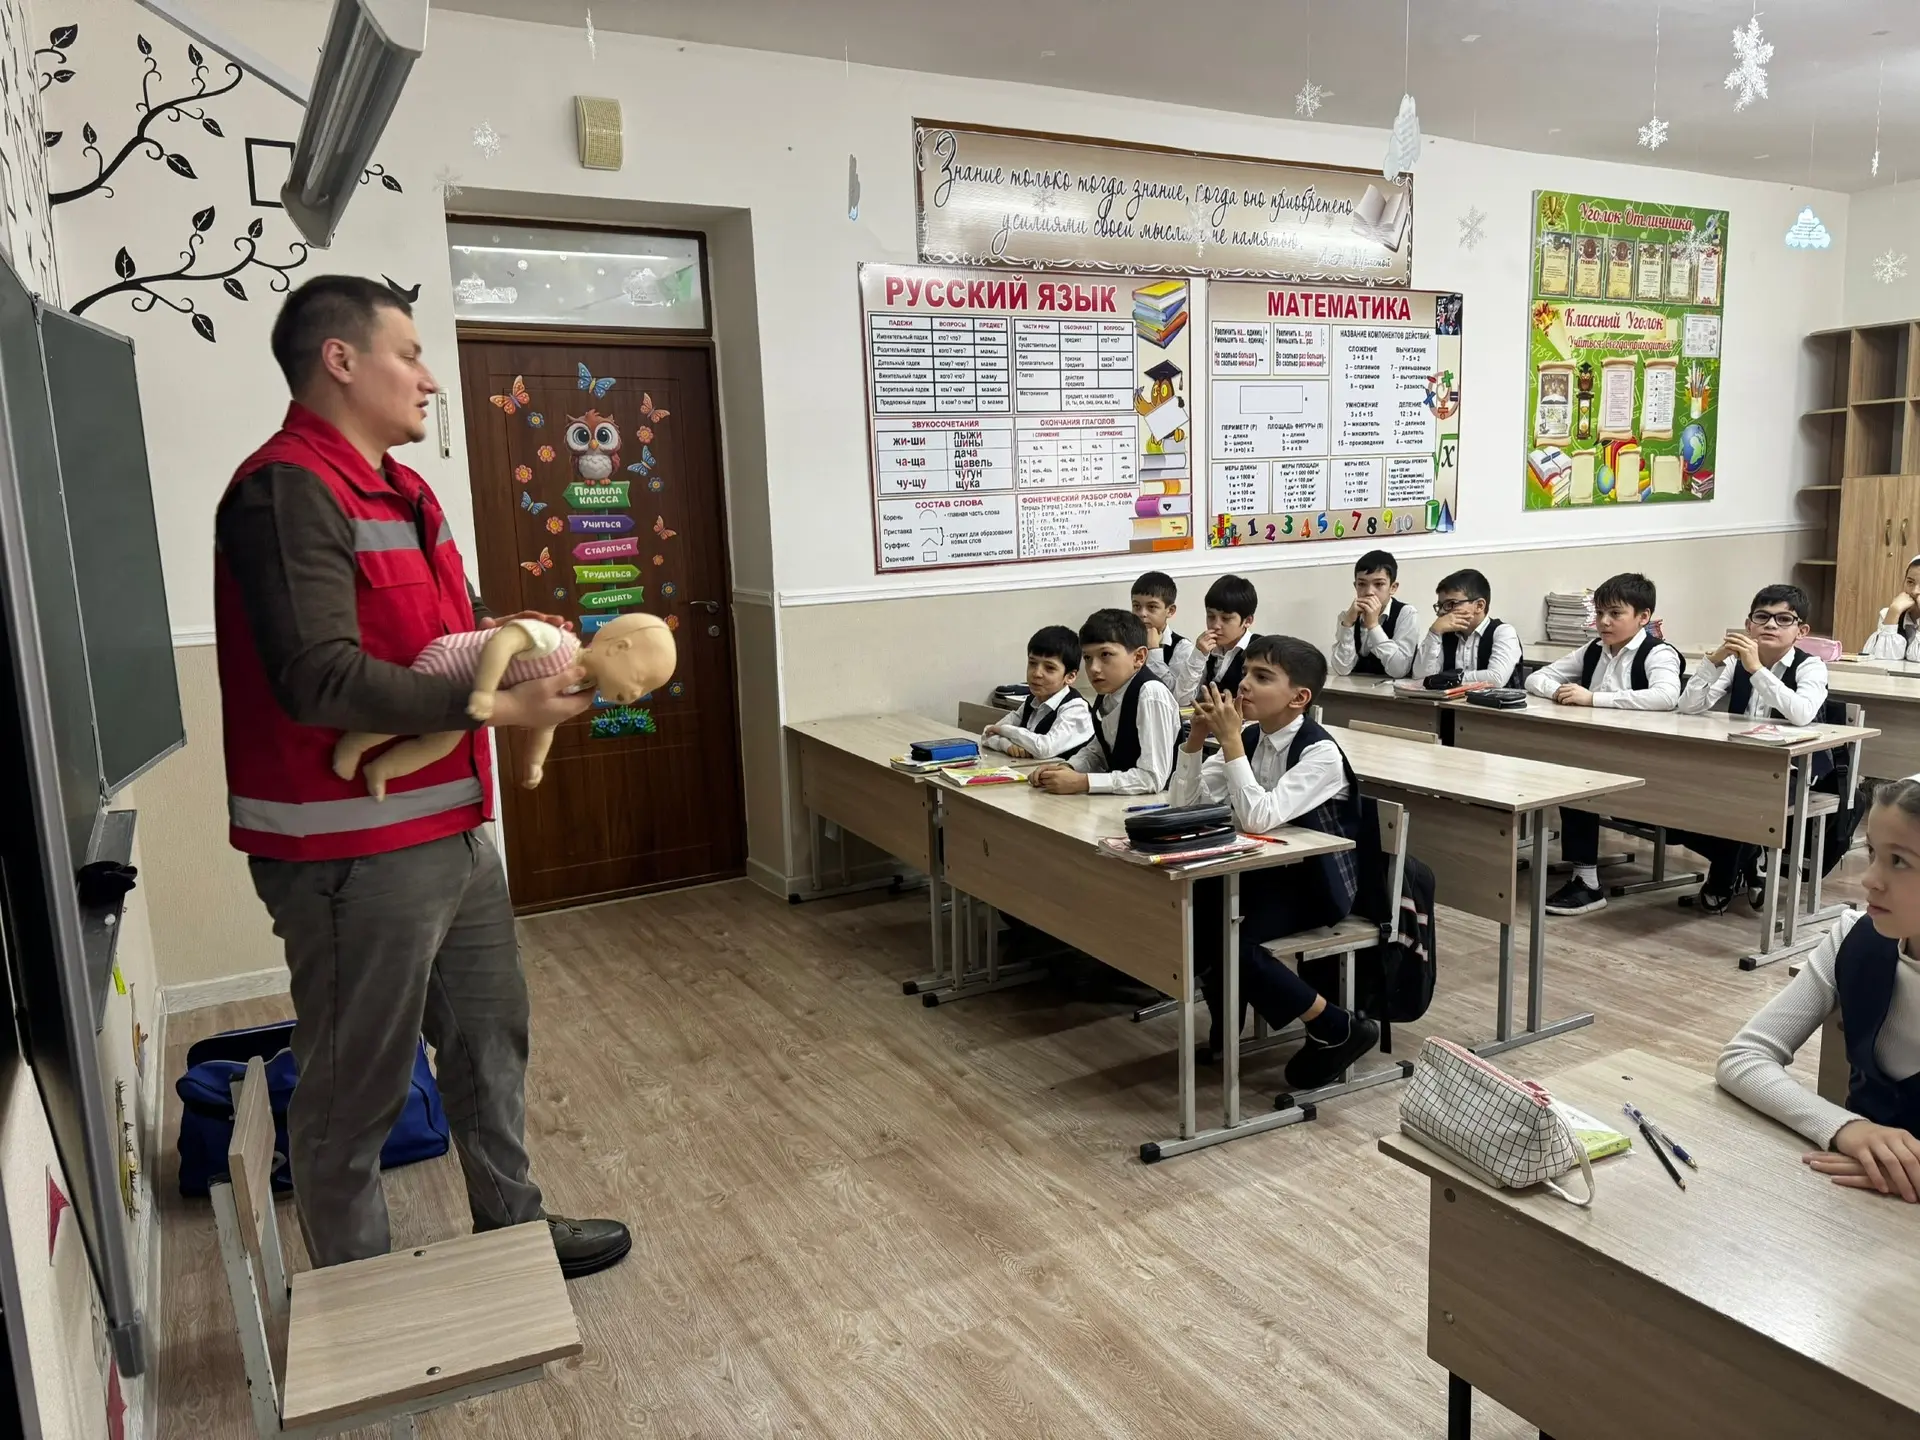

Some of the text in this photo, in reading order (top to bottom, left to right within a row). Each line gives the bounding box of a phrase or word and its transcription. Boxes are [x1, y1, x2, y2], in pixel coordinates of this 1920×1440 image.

[934, 131, 1005, 208] Знание
[1010, 169, 1073, 191] только
[1077, 175, 1127, 220] тогда
[1126, 179, 1189, 222] знание,
[1243, 190, 1267, 208] оно
[1269, 185, 1354, 223] приобретено
[1579, 203, 1693, 231] Уголок Отличника
[1212, 229, 1228, 244] не
[886, 276, 1117, 315] РУССКИЙ ЯЗЫК
[1268, 292, 1411, 320] МАТЕМАТИКА
[1565, 308, 1664, 330] Классный Уголок
[1340, 330, 1367, 338] НАЗВАНИЕ
[1368, 331, 1404, 340] КОМПОНЕНТОВ
[912, 421, 980, 429] ЗВУКОСОЧЕТАНИЯ
[1040, 418, 1115, 427] ОКОНЧАНИЯ ГЛАГОЛОВ
[953, 431, 982, 440] лыжи
[893, 437, 926, 446] жи-ши
[954, 439, 983, 448] шины
[955, 449, 978, 460] дача
[896, 457, 926, 467] ча-ща
[955, 459, 993, 469] щавель
[955, 469, 982, 480] чугун
[897, 478, 927, 490] чу-щу
[956, 479, 980, 491] щука
[1022, 496, 1079, 504] ФОНЕТИЧЕСКИЙ
[1248, 509, 1413, 542] 1 2 3 4 5 6 7 8 9 10
[884, 528, 912, 536] Приставка
[884, 542, 910, 550] Суффикс
